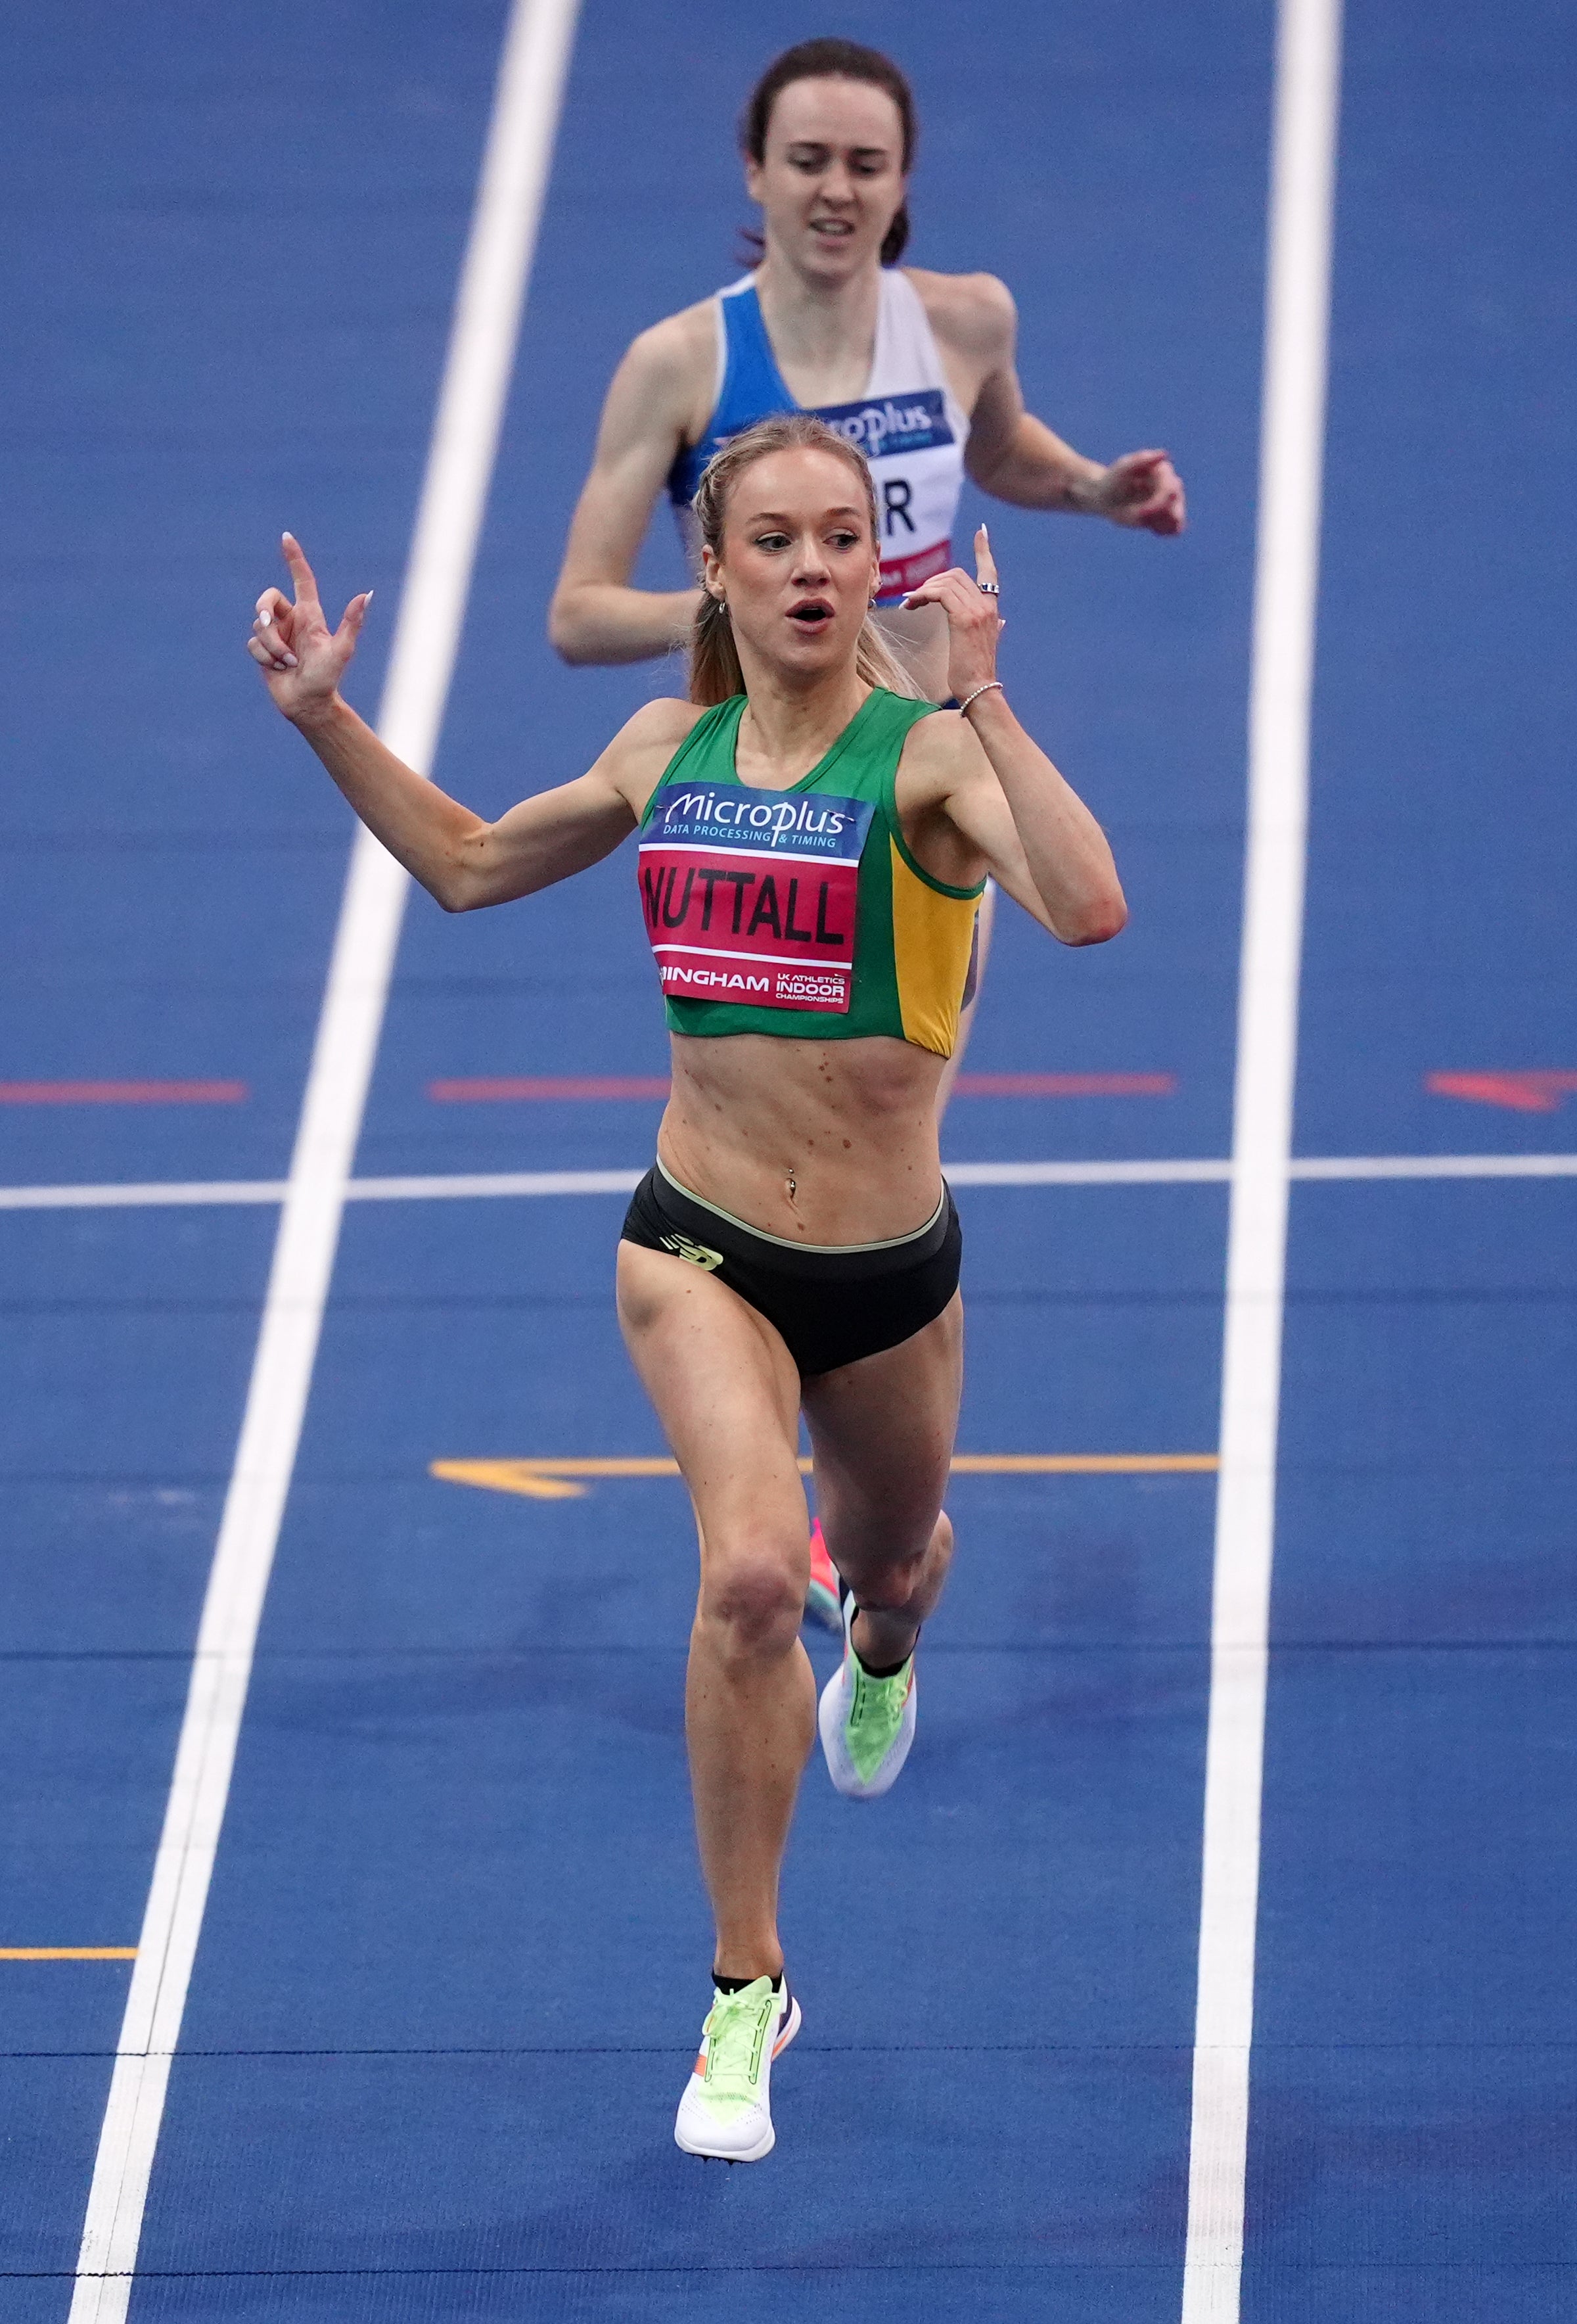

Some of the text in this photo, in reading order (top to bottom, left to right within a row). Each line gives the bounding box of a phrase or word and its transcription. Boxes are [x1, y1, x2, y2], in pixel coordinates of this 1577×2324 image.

[883, 480, 916, 536] R
[665, 792, 844, 847] Microplus
[663, 825, 836, 848] DATA PROCESSING & TIMING
[645, 867, 844, 944] NUTTALL
[776, 981, 844, 997] INDOOR
[791, 975, 845, 985] ATHLETICS
[775, 992, 844, 1004] CHAMPIONSHIPS
